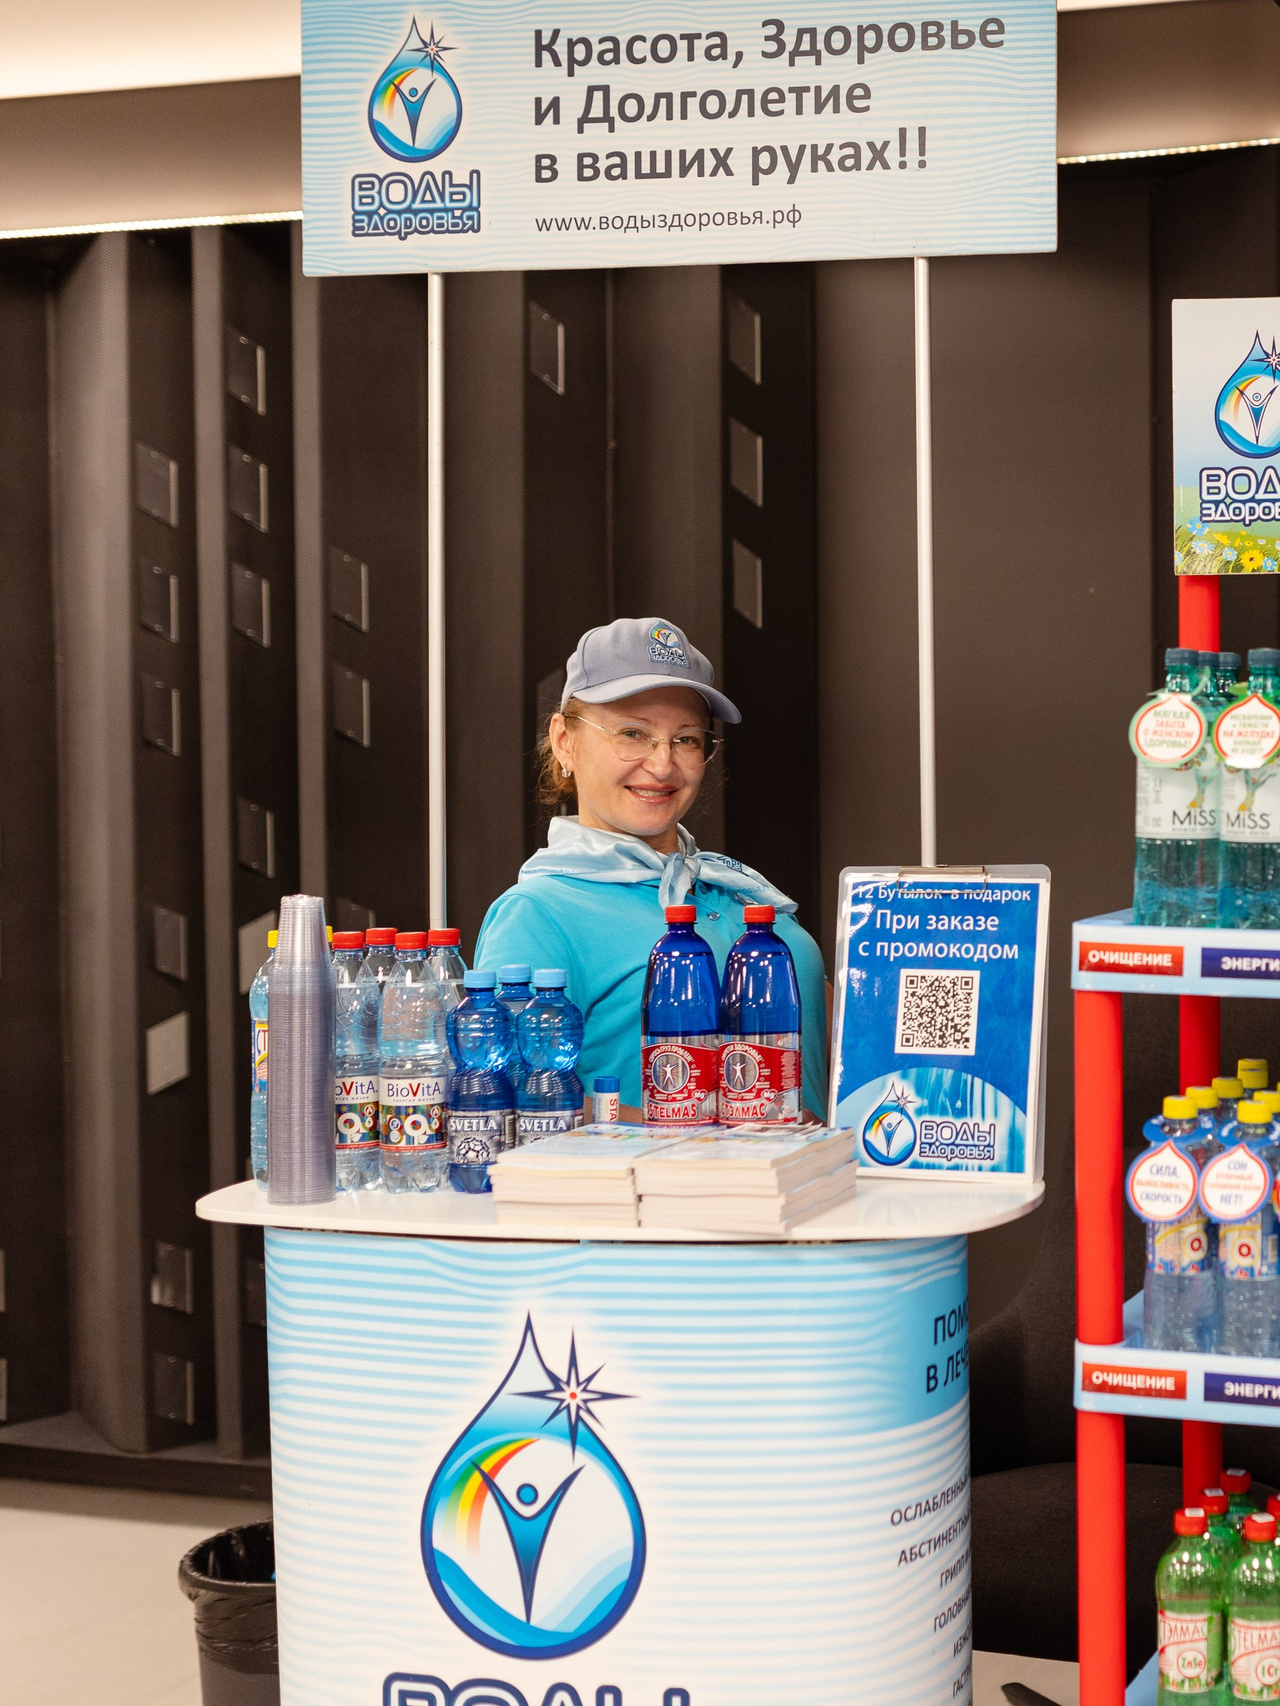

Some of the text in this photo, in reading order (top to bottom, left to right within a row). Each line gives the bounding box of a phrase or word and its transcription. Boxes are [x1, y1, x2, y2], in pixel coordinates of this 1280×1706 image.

[533, 12, 1007, 76] Красота, Здоровье
[533, 81, 873, 135] и Долголетие
[533, 126, 931, 187] в ваших руках!!
[351, 169, 482, 212] ВОДЫ
[534, 204, 803, 235] www.водыздоровья.рф
[878, 885, 942, 902] Бутылок
[963, 887, 1031, 903] подарок
[876, 909, 999, 933] При заказе
[858, 941, 1019, 961] с промокодом
[1088, 950, 1173, 968] ОЧИЩЕНИЕ
[648, 1102, 698, 1119] STELMAS
[721, 1102, 767, 1119] СТЭЛМАС
[450, 1117, 498, 1131] SVETLA
[520, 1118, 567, 1131] SVETLA
[919, 1120, 996, 1146] ВОДЫ
[1150, 1164, 1180, 1178] СИЛА,
[1228, 1161, 1248, 1171] СОН
[927, 1364, 938, 1394] В
[1091, 1370, 1176, 1392] ОЧИЩЕНИЕ
